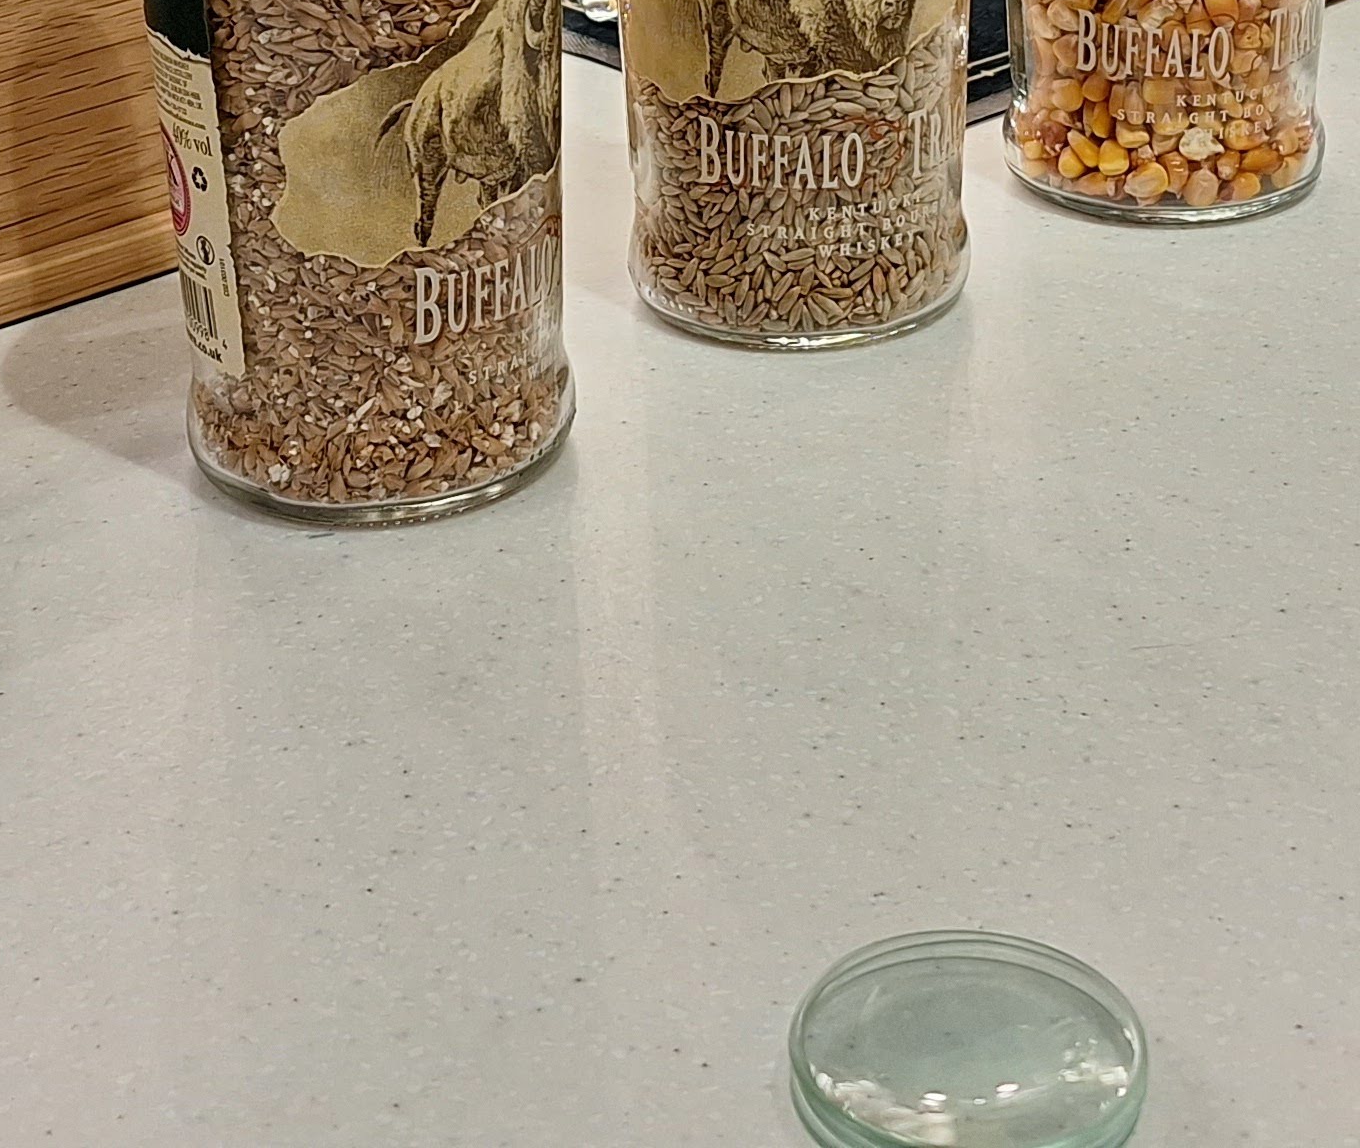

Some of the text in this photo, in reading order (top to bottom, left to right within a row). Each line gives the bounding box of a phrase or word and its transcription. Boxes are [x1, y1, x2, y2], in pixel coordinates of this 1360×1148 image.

[1076, 8, 1232, 80] BUFFALO
[1175, 82, 1281, 108] KENTUCKY
[1116, 108, 1229, 125] STRAIGHT
[193, 135, 214, 157] vol
[698, 115, 864, 189] BUFFALO
[746, 222, 867, 241] STRAIGHT
[818, 229, 916, 258] WHISKEY
[414, 233, 554, 347] BUFFALO
